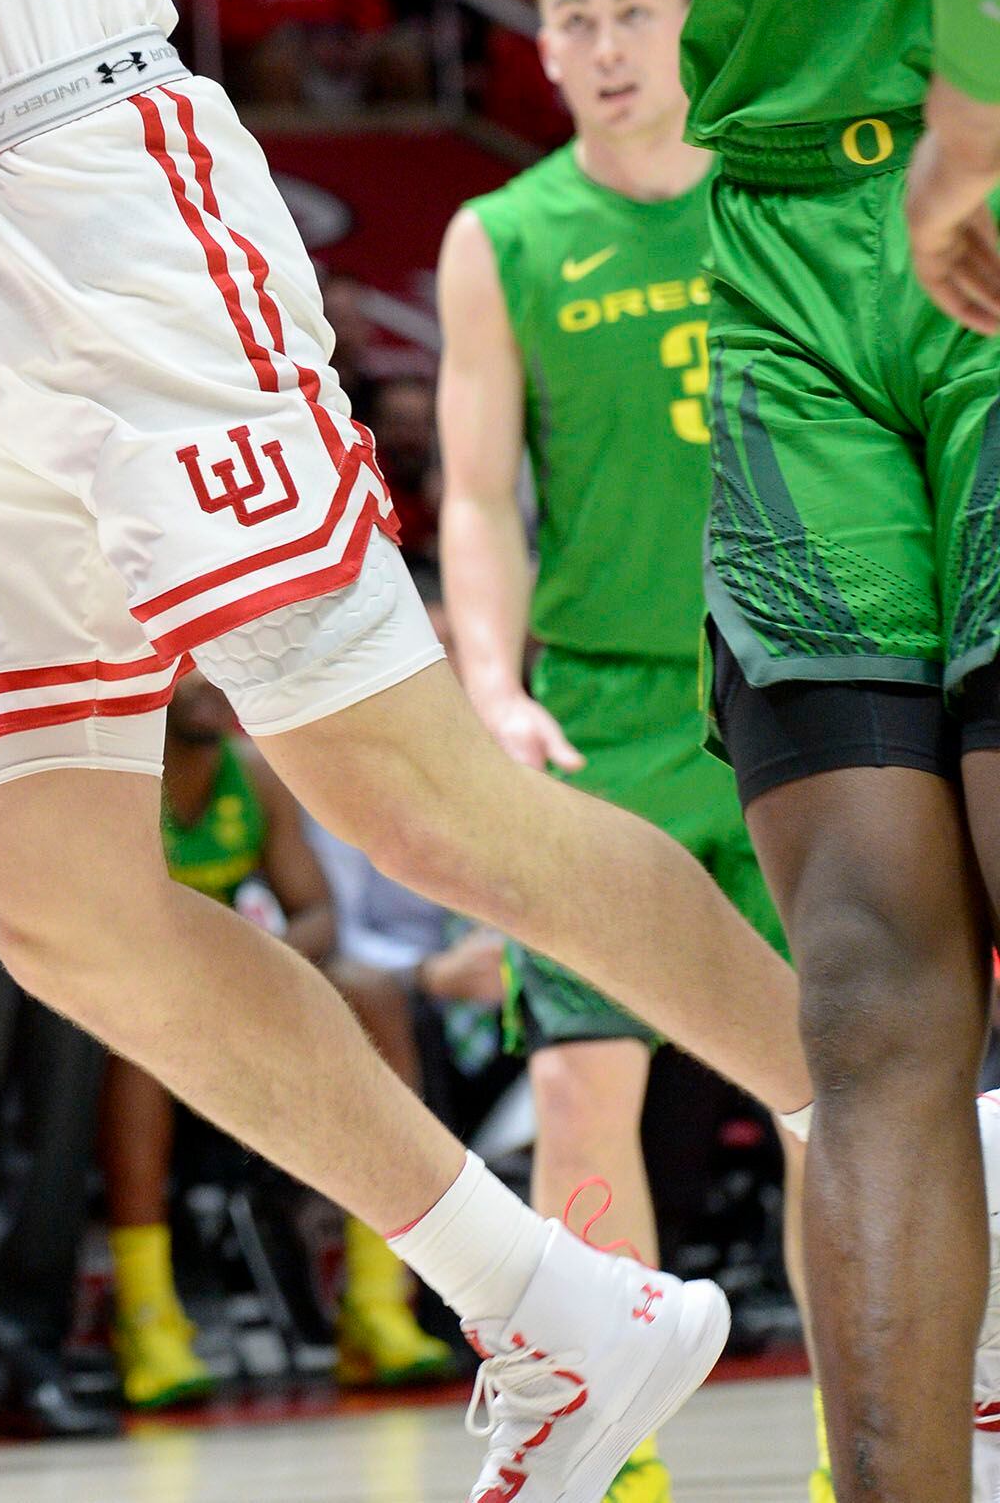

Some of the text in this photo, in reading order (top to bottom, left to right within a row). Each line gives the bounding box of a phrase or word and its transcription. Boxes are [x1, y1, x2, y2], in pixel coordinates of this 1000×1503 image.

[14, 75, 90, 119] UNDER
[841, 118, 894, 166] O
[557, 276, 712, 334] OREG
